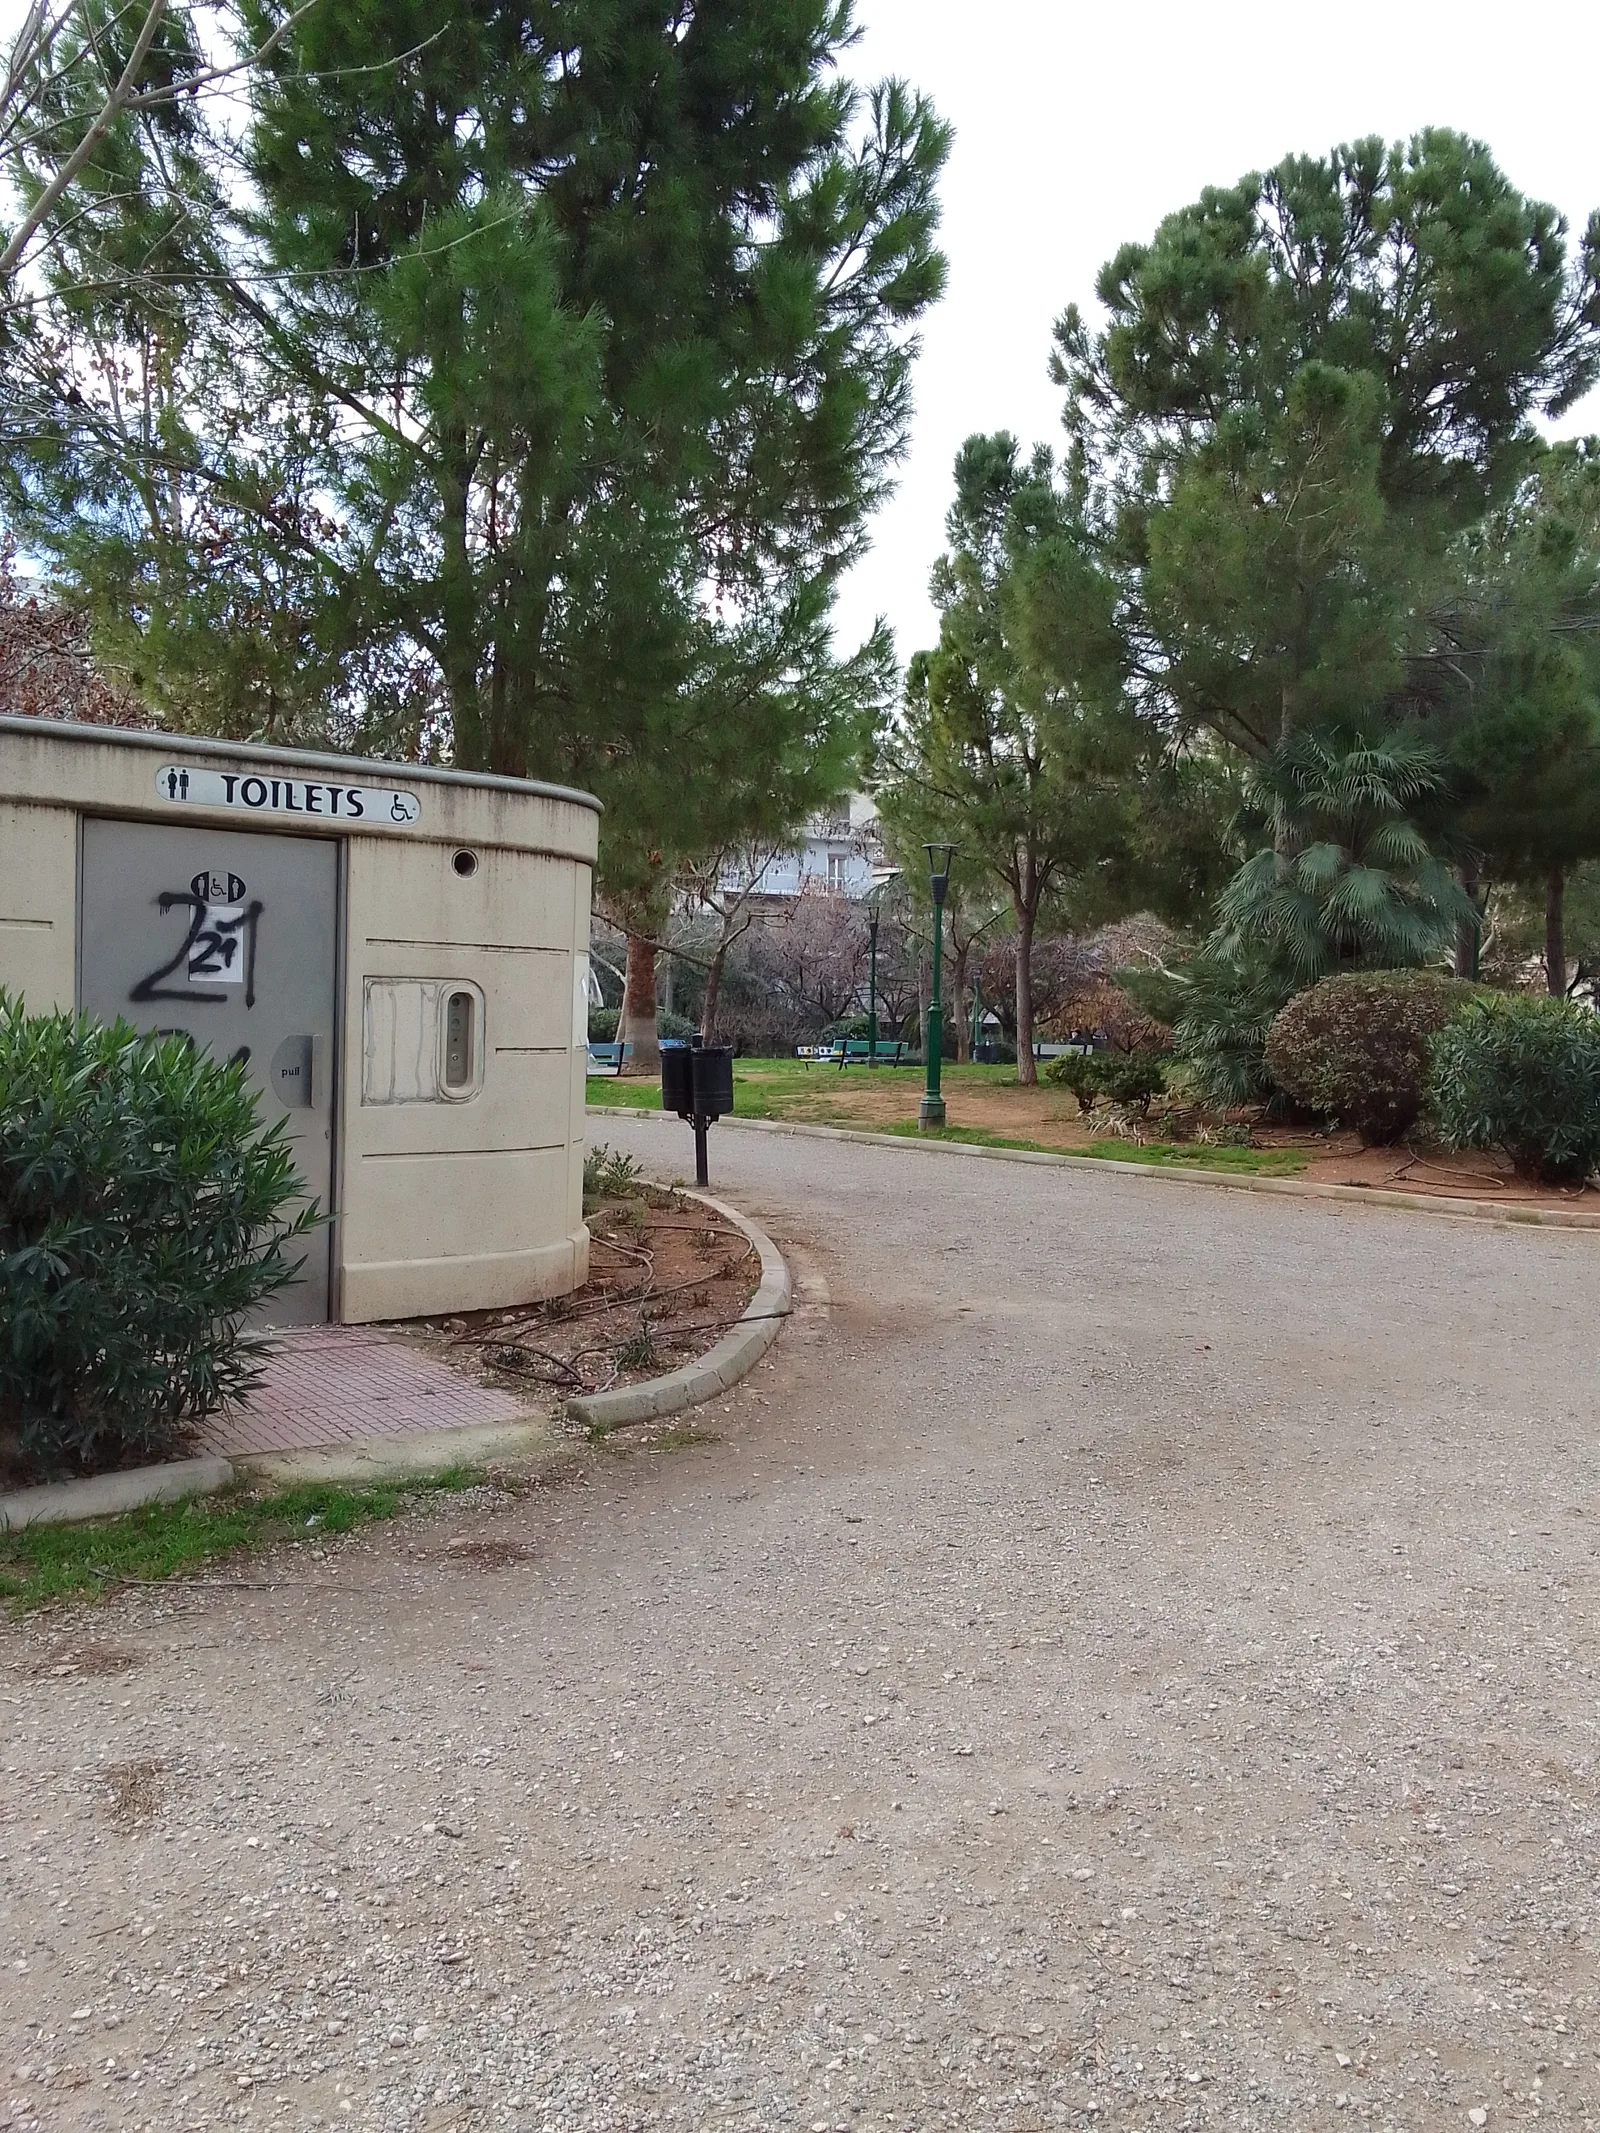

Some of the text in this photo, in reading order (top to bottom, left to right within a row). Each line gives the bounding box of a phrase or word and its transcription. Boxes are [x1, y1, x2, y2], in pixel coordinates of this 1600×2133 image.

[220, 774, 364, 817] TOILETS
[188, 931, 238, 974] 21
[281, 1066, 300, 1079] pull
